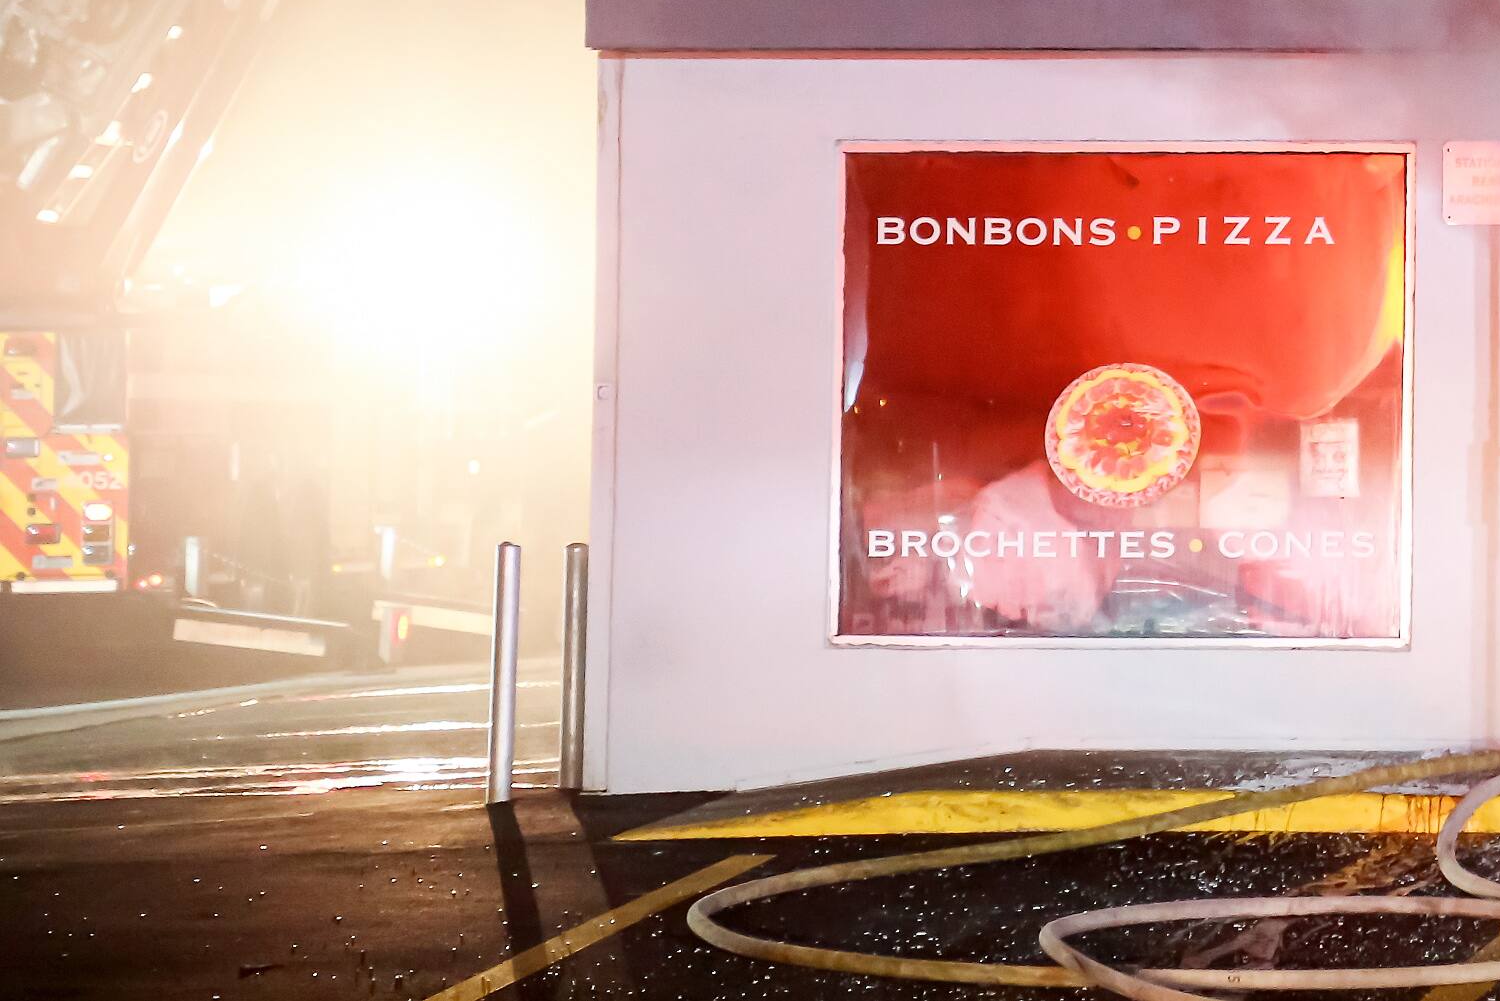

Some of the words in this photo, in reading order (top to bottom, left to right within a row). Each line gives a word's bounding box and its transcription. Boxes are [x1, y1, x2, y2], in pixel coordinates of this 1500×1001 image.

[876, 216, 1117, 247] BONBONS
[1152, 216, 1336, 246] PIZZA
[64, 470, 123, 491] 052
[867, 530, 1177, 560] BROCHETTES
[1217, 530, 1377, 560] CONES
